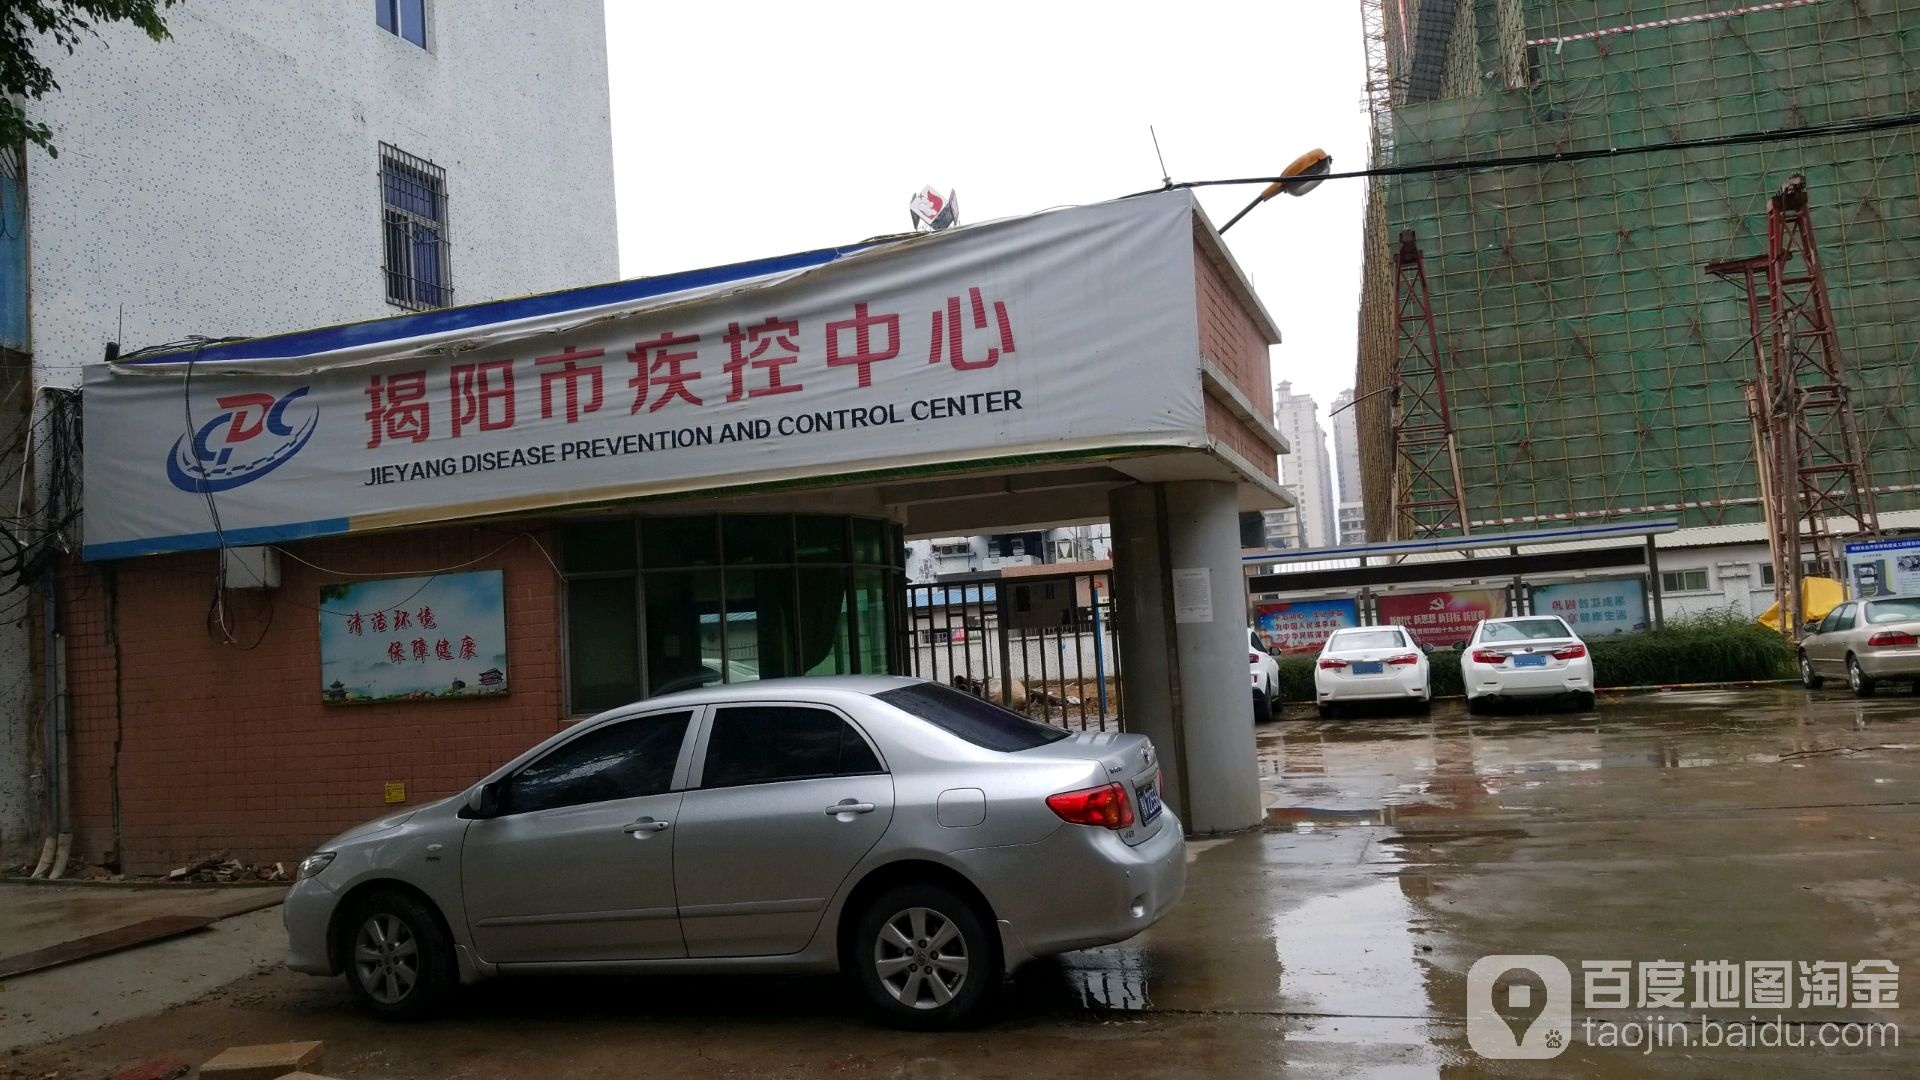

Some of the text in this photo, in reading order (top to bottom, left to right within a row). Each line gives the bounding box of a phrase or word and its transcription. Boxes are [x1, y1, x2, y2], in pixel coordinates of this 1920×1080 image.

[364, 287, 1017, 450] 揭阳市疾控中心
[363, 389, 1024, 487] JIEYANG DISEASE PREVENTION AND CONTROL CENTER
[346, 604, 439, 638] 清洁环境
[1413, 613, 1437, 625] 新思想
[1438, 611, 1462, 624] 新目标
[387, 634, 480, 665] 保障健康
